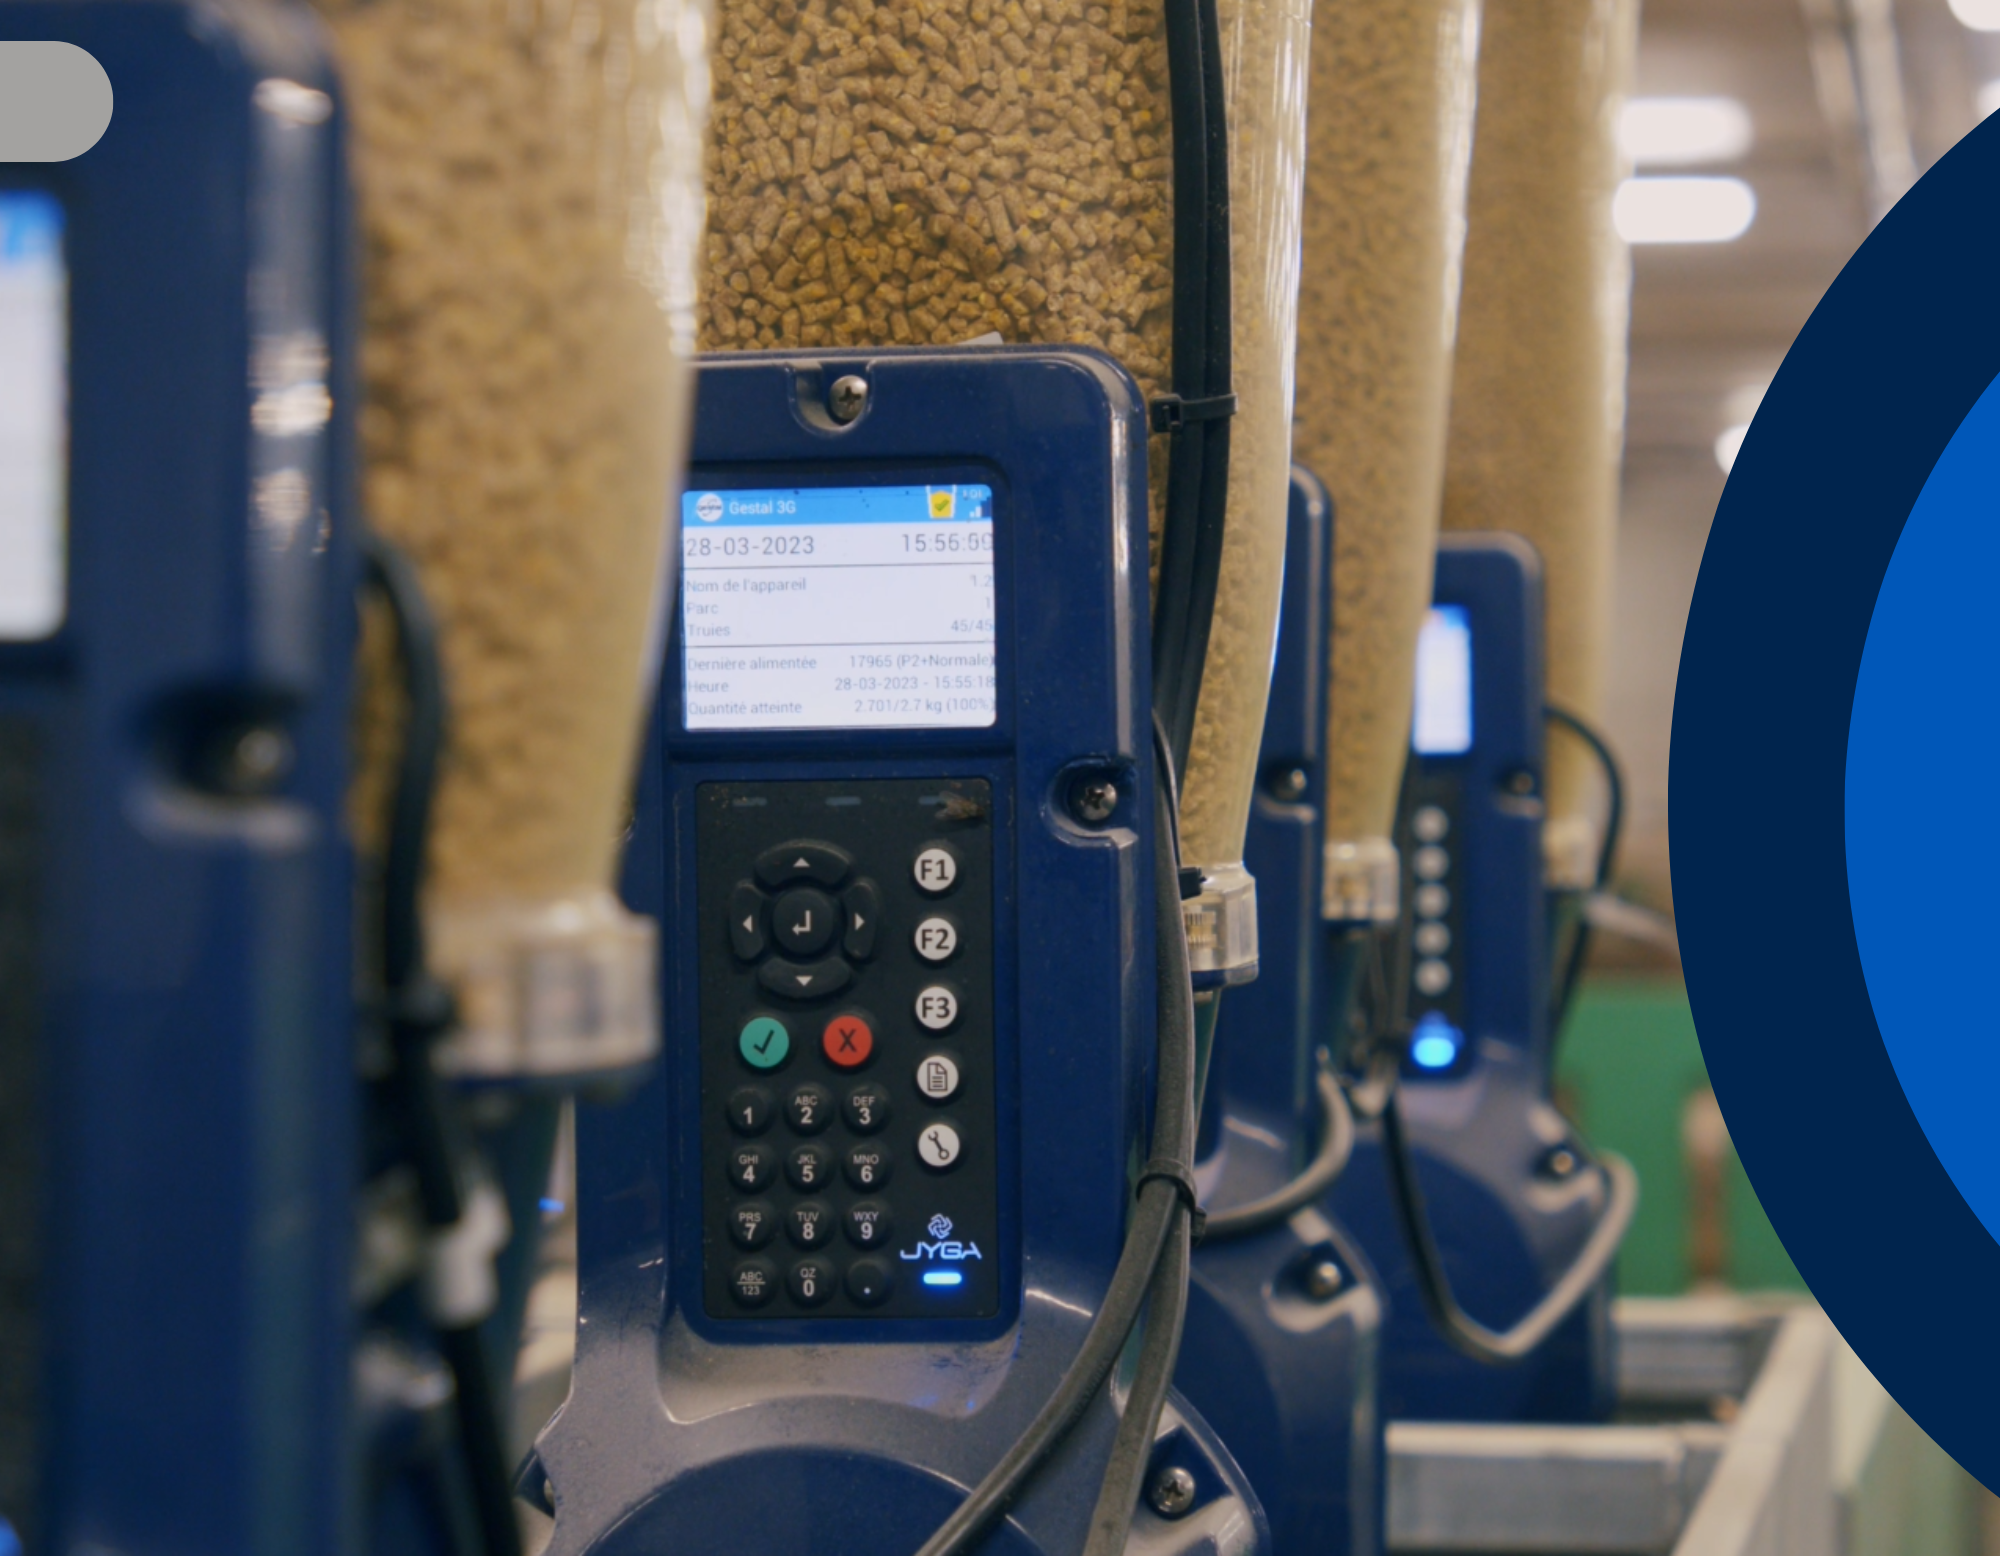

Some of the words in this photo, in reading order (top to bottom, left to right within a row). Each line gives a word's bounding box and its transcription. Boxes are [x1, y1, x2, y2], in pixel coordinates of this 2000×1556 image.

[728, 500, 773, 515] Gestal
[777, 500, 797, 514] 3G
[686, 535, 815, 557] 28-03-2023
[686, 579, 719, 592] Nom
[723, 578, 740, 592] de
[743, 577, 807, 594] l'appareil
[686, 602, 719, 615] Parc
[687, 622, 732, 637] Truies
[950, 618, 994, 632] 45/45
[687, 656, 746, 671] Dernière
[749, 655, 818, 670] alimentée
[849, 654, 893, 668] 17965
[687, 681, 729, 693] Heure
[834, 676, 919, 691] 28-03-2023
[687, 701, 747, 716] Quantité
[750, 700, 803, 714] atteinte
[854, 698, 922, 713] 2.701/2.7
[925, 698, 943, 715] kg
[920, 859, 950, 881] F1
[921, 928, 951, 950] F2
[921, 997, 951, 1019] F3
[794, 1095, 818, 1106] ABC
[852, 1095, 876, 1107] DEF
[743, 1106, 753, 1125] 1
[801, 1106, 813, 1124] 2
[859, 1107, 871, 1125] 3
[738, 1154, 759, 1165] GHI
[797, 1154, 817, 1165] JKL
[852, 1154, 880, 1165] MNO
[742, 1165, 755, 1183] 4
[802, 1165, 814, 1182] 5
[860, 1165, 873, 1183] 6
[738, 1211, 762, 1222] PRS
[796, 1211, 819, 1222] TUV
[853, 1211, 879, 1222] WXY
[744, 1223, 757, 1240] 7
[802, 1222, 814, 1240] 8
[860, 1222, 873, 1240] 9
[900, 1241, 983, 1260] JYGA
[739, 1271, 763, 1282] ABC
[742, 1286, 760, 1296] 123
[803, 1279, 815, 1297] 0
